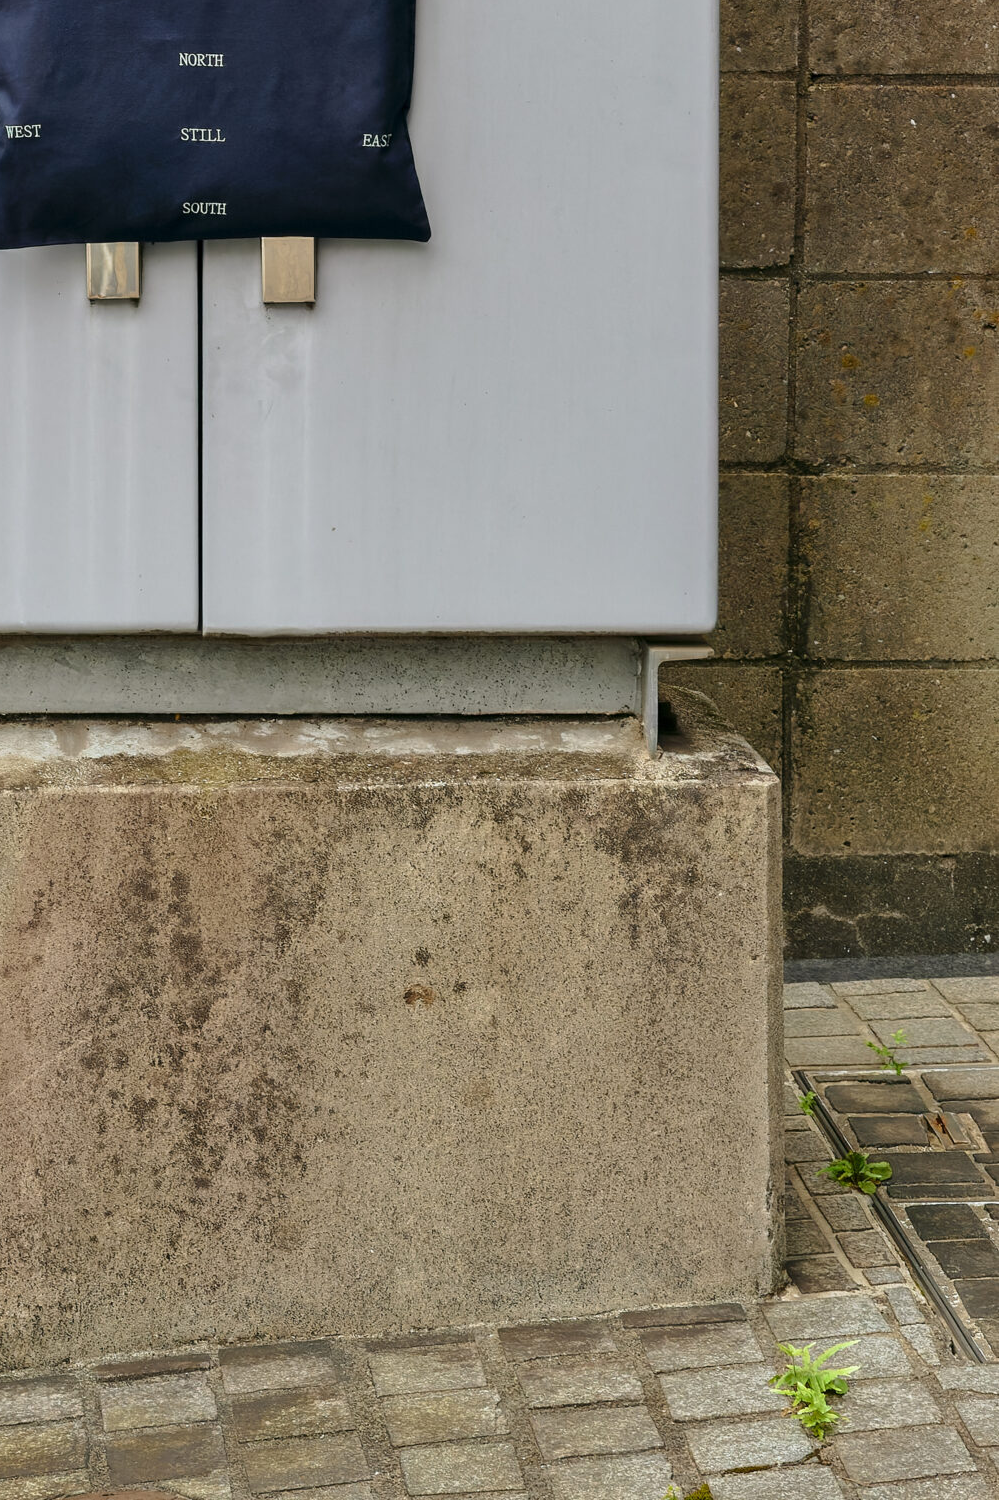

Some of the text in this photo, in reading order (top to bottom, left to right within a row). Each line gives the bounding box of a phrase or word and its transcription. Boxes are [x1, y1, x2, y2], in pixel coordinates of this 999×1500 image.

[178, 52, 224, 68] NORTH
[4, 124, 42, 139] WEST
[180, 127, 226, 143] STILL
[182, 202, 227, 216] SOUTH
